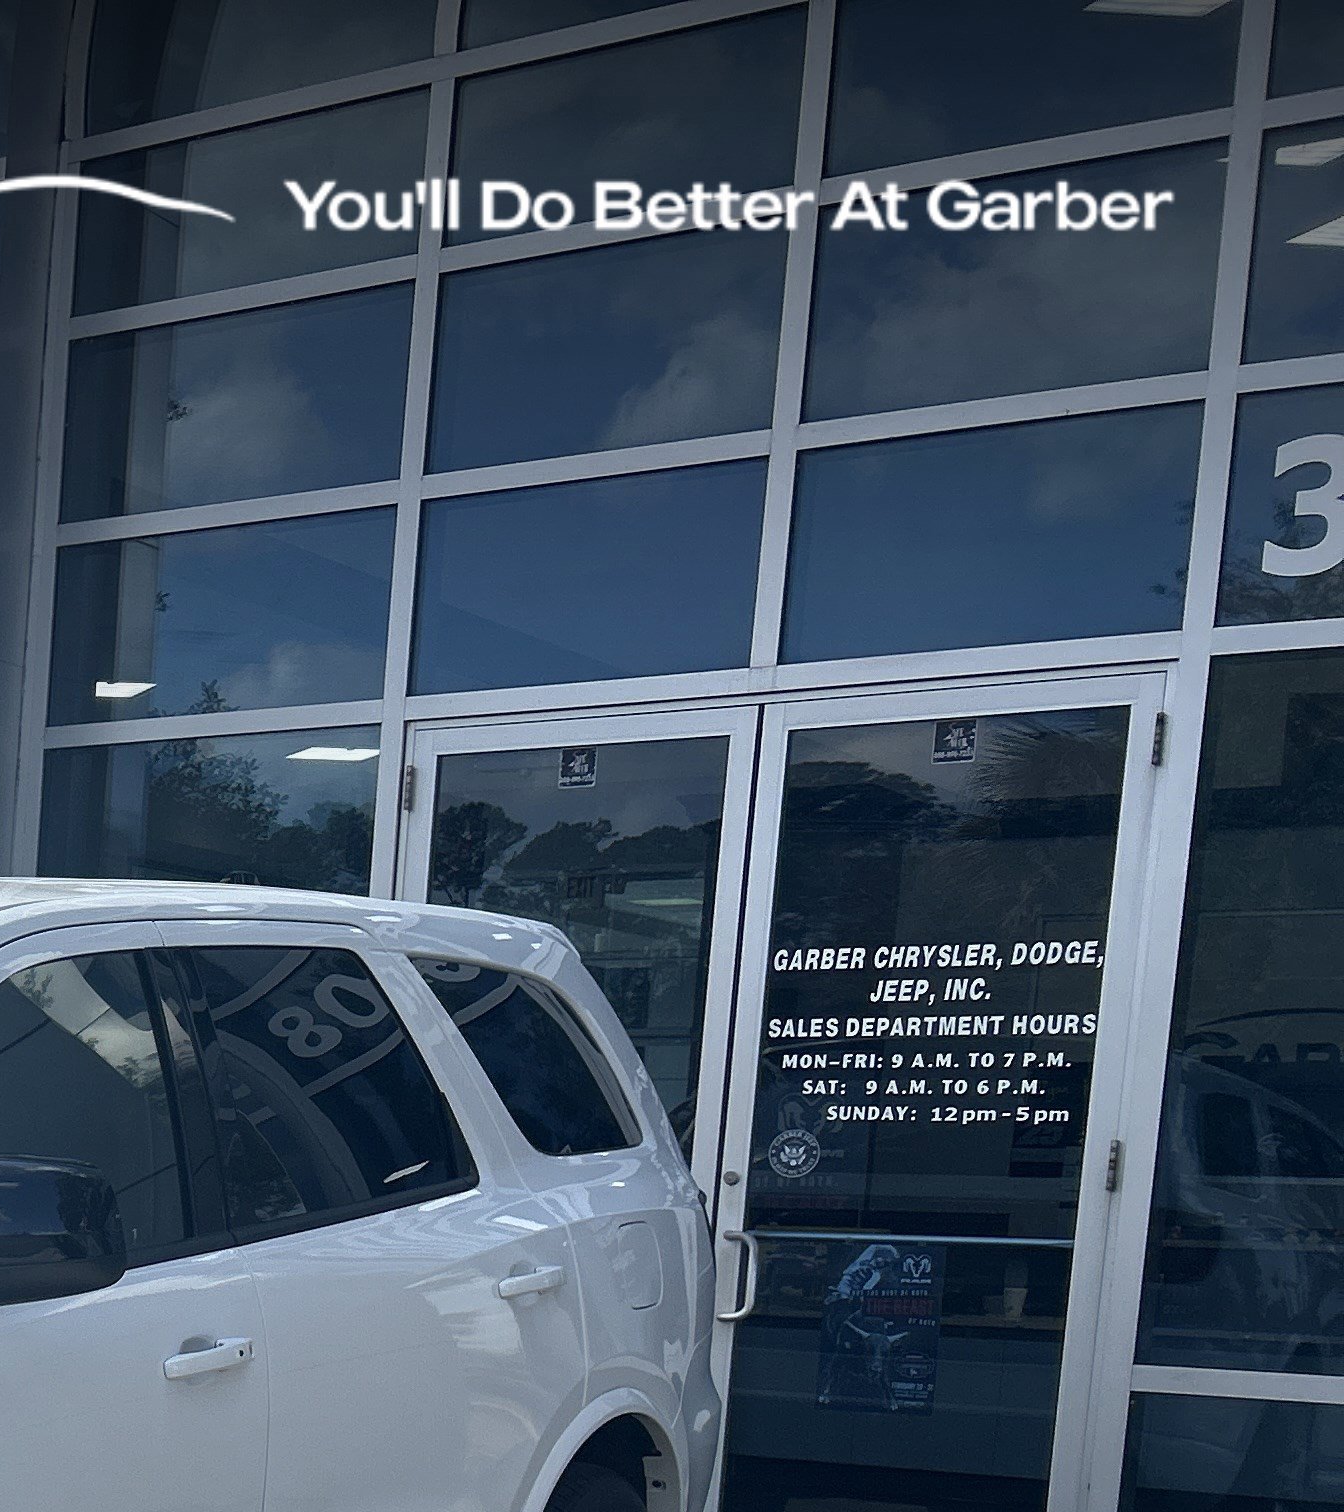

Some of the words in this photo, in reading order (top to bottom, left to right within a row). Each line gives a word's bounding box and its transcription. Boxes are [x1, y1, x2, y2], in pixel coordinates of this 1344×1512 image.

[773, 947, 866, 972] GARBER
[873, 943, 1003, 971] CHRYSLER,
[1009, 940, 1105, 968] DODGE,
[869, 979, 936, 1006] JEEP,
[943, 977, 991, 1001] INC.
[768, 1017, 839, 1038] SALES
[845, 1015, 1005, 1037] DEPARTMENT
[1012, 1013, 1098, 1035] HOURS
[891, 1053, 904, 1069] 9
[910, 1053, 959, 1068] A.M.
[968, 1052, 995, 1068] TO
[1003, 1053, 1016, 1068] 7
[1022, 1052, 1072, 1068] P.M.
[801, 1079, 846, 1095] SAT:
[865, 1080, 878, 1095] 9
[885, 1079, 933, 1095] A.M.
[941, 1079, 968, 1095] TO
[976, 1079, 990, 1095] 6
[996, 1079, 1045, 1095] P.M.
[826, 1105, 917, 1121] SUNDAY:
